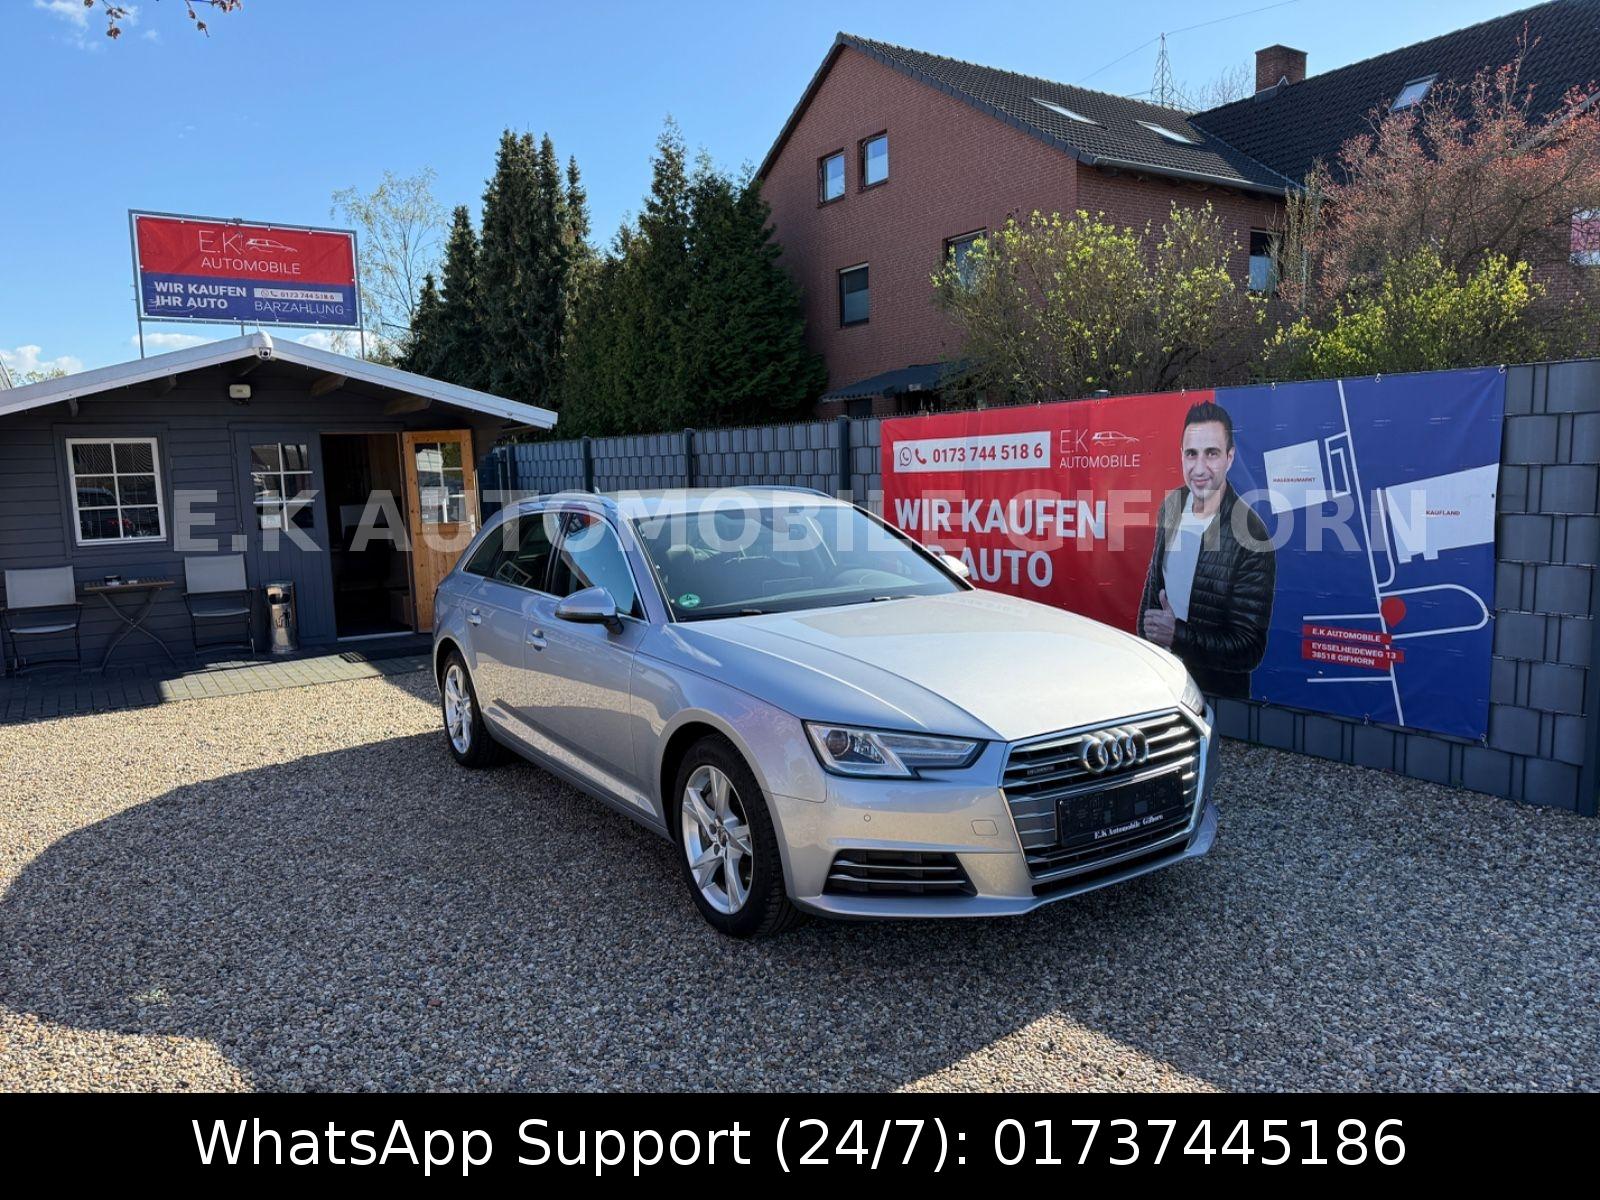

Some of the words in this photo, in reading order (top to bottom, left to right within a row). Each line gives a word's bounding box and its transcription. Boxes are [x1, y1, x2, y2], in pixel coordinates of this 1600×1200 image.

[198, 230, 242, 255] E.K
[201, 257, 300, 275] AUTOMOBILE
[154, 281, 184, 294] WIR
[187, 283, 247, 298] KAUFEN
[155, 295, 183, 308] IHR
[186, 296, 229, 310] AUTO
[254, 301, 344, 315] BARZAHLUNG
[1059, 429, 1089, 454] E.K
[932, 447, 966, 463] 0173
[970, 445, 997, 461] 744
[1001, 444, 1029, 460] 518
[1033, 442, 1043, 459] 6
[1059, 454, 1141, 469] AUTOMOBILE
[894, 498, 952, 532] WIR
[962, 499, 1106, 540] KAUFEN
[960, 547, 1053, 588] AUTO
[1312, 627, 1326, 636] E.K
[1326, 629, 1381, 643] AUTOMOBILE
[1311, 642, 1384, 658] EYSSELHEIDEWEG
[1385, 651, 1397, 660] 13
[1311, 651, 1336, 661] 38518
[1337, 655, 1375, 666] GIFHORN
